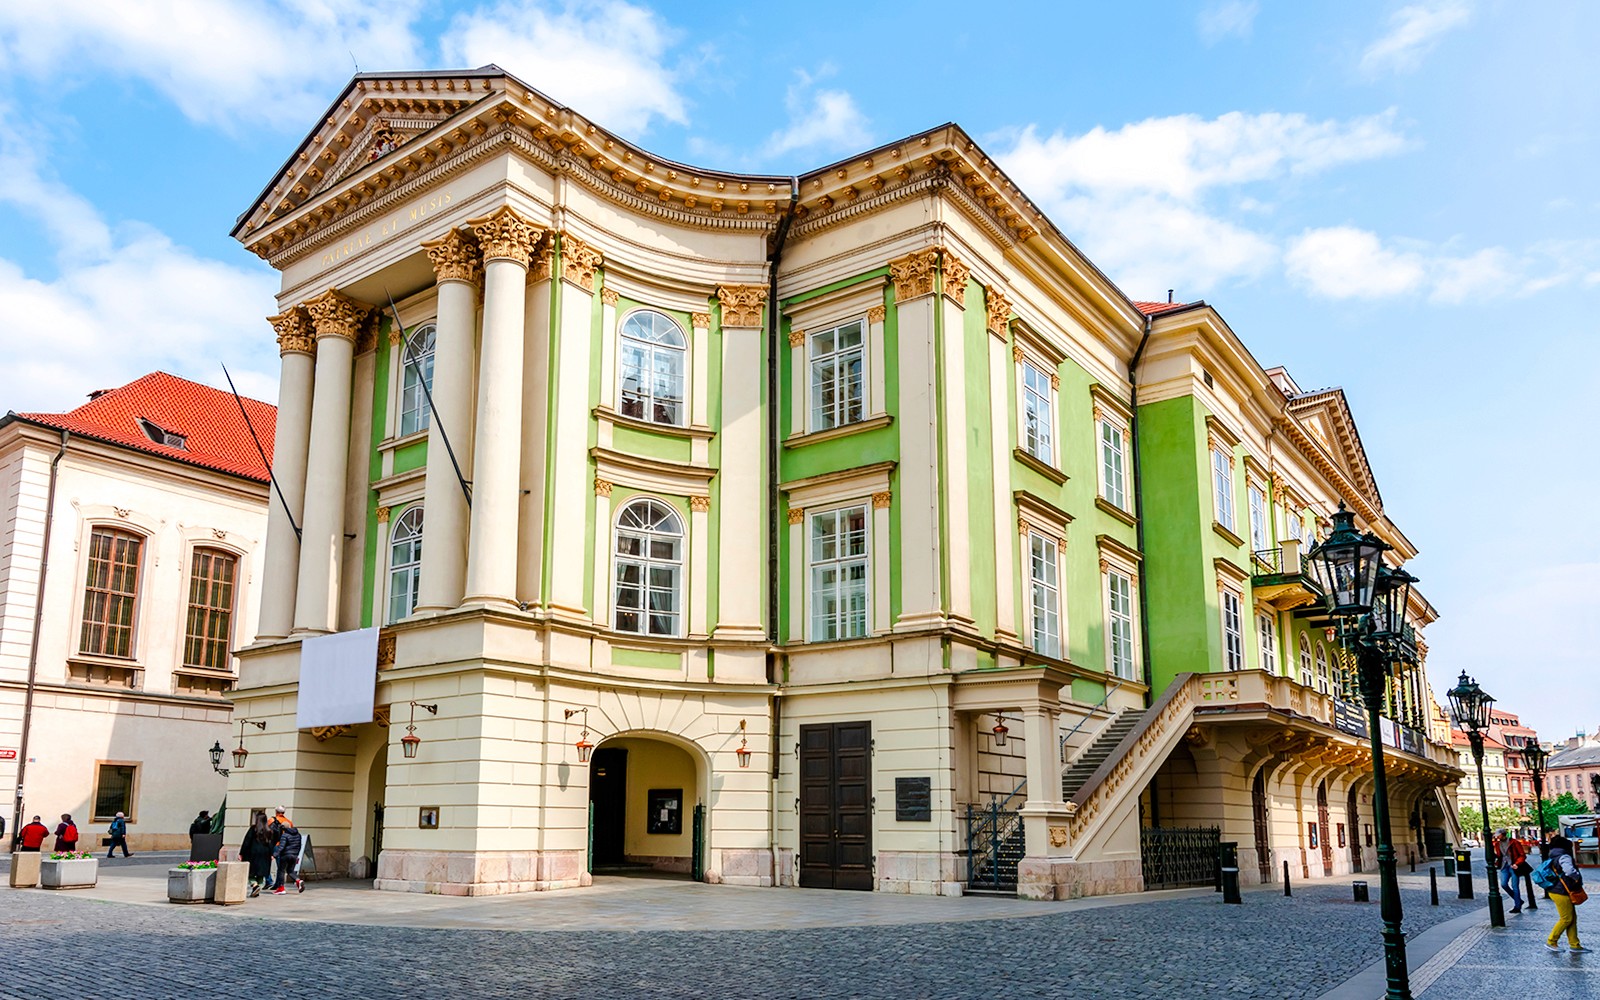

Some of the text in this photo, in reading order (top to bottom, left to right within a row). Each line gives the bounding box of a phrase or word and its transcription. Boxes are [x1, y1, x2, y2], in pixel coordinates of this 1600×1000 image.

[321, 192, 452, 266] PATRIAE ET MUSIS
